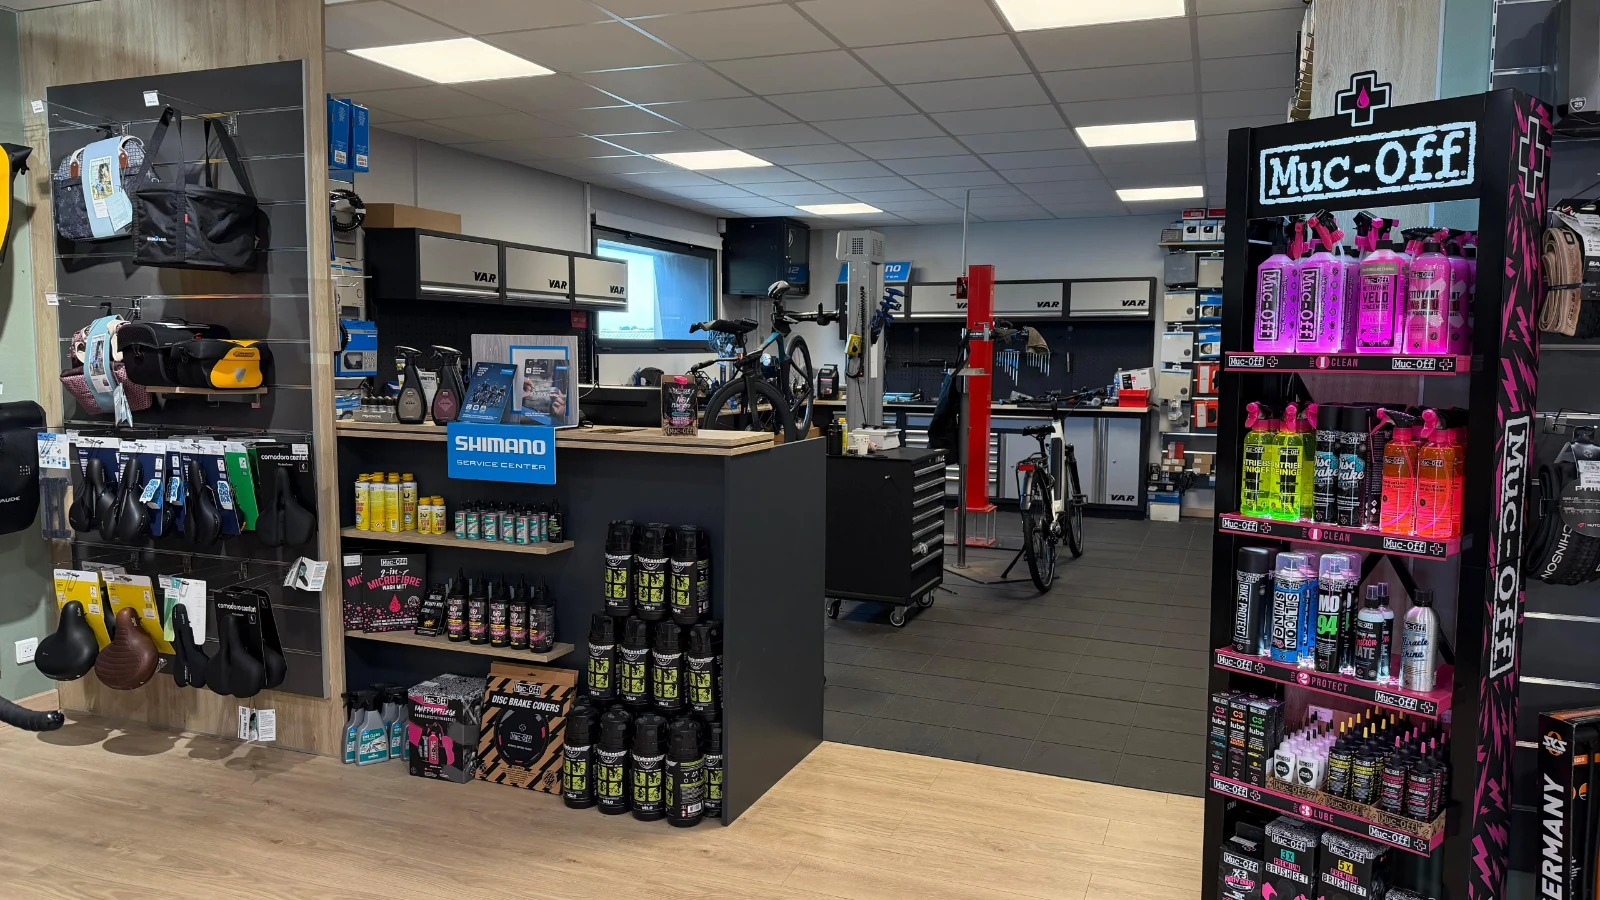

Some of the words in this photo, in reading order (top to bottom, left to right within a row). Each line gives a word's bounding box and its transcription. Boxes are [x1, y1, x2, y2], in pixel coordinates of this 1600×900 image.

[1268, 130, 1466, 196] Muc-Off
[473, 271, 497, 283] VAR
[548, 279, 568, 290] VAR
[610, 285, 625, 295] VAR
[1363, 292, 1389, 303] VELO
[1121, 299, 1147, 307] VAR
[1260, 273, 1278, 336] Muc-Off
[1300, 272, 1315, 338] Muc-Off
[1230, 357, 1263, 366] Muc-Off
[1331, 358, 1358, 367] CLEAN
[1394, 359, 1434, 369] Muc-Off
[455, 436, 546, 455] SHIMANO
[1223, 519, 1257, 532] Muc-Off
[1323, 531, 1350, 542] CLEAN
[1385, 540, 1425, 553] Muc-Off
[1495, 430, 1525, 665] Muc-Off
[1541, 524, 1573, 580] CHINSON
[367, 575, 422, 590] MICROFIBRE
[1238, 584, 1249, 602] BIKE
[1236, 602, 1247, 637] PROTECT
[1317, 615, 1338, 635] 94
[1218, 654, 1251, 671] Muc-Off
[515, 683, 540, 695] Muc-Off
[1311, 676, 1348, 693] PROTECT
[424, 696, 448, 706] Muc-Off
[492, 695, 508, 705] DISC
[509, 697, 532, 708] BRAKE
[532, 702, 560, 712] COVERS
[1376, 692, 1416, 710] Muc-Off
[1212, 717, 1226, 726] lube
[1233, 710, 1243, 718] C3
[1252, 716, 1263, 724] C3
[1230, 721, 1245, 730] lube
[1249, 726, 1265, 737] lube
[1214, 779, 1247, 798] Muc-Off
[1314, 809, 1334, 822] LUBE
[1273, 834, 1305, 852] Muc-Off
[1370, 827, 1410, 847] Muc-Off
[1542, 773, 1565, 900] ERMANY
[1330, 844, 1364, 863] Muc-Off
[1225, 853, 1258, 873] Muc-Off
[1266, 863, 1292, 878] BRUSH
[1292, 874, 1308, 884] SET
[1322, 873, 1350, 889] BRUSH
[1350, 884, 1366, 897] SET
